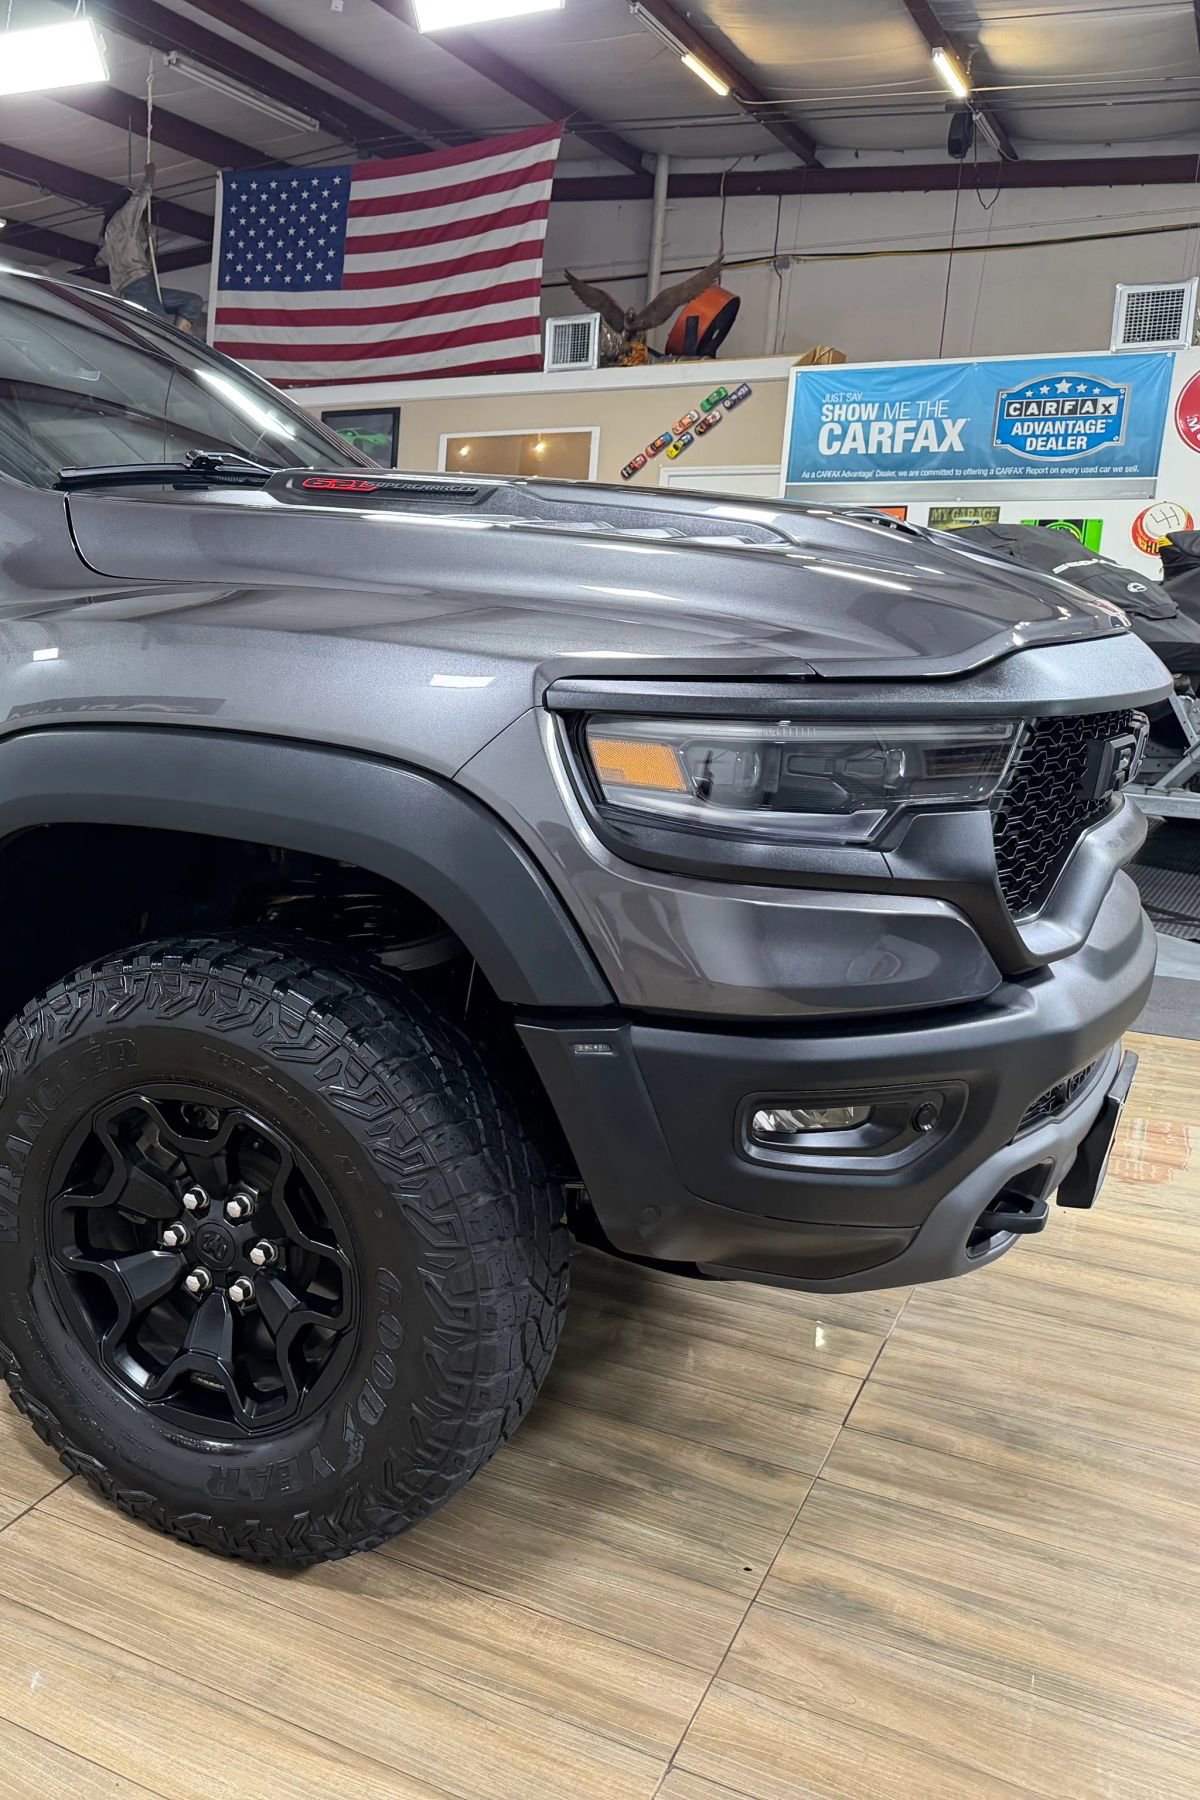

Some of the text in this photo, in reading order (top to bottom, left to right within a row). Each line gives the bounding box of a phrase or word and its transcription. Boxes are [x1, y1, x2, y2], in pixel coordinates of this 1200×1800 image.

[823, 392, 863, 403] JUST SAY
[821, 400, 950, 422] SHOW ME THE
[1007, 400, 1115, 416] CARFAX
[818, 418, 967, 456] CARFAX
[1025, 435, 1088, 451] DEALER
[920, 468, 954, 477] committed
[963, 468, 988, 477] offering
[1025, 466, 1048, 475] Report
[1060, 467, 1079, 475] every
[1125, 465, 1139, 473] sell.
[367, 479, 478, 493] SUPERCHARGED
[930, 507, 998, 522] MY GARAGE
